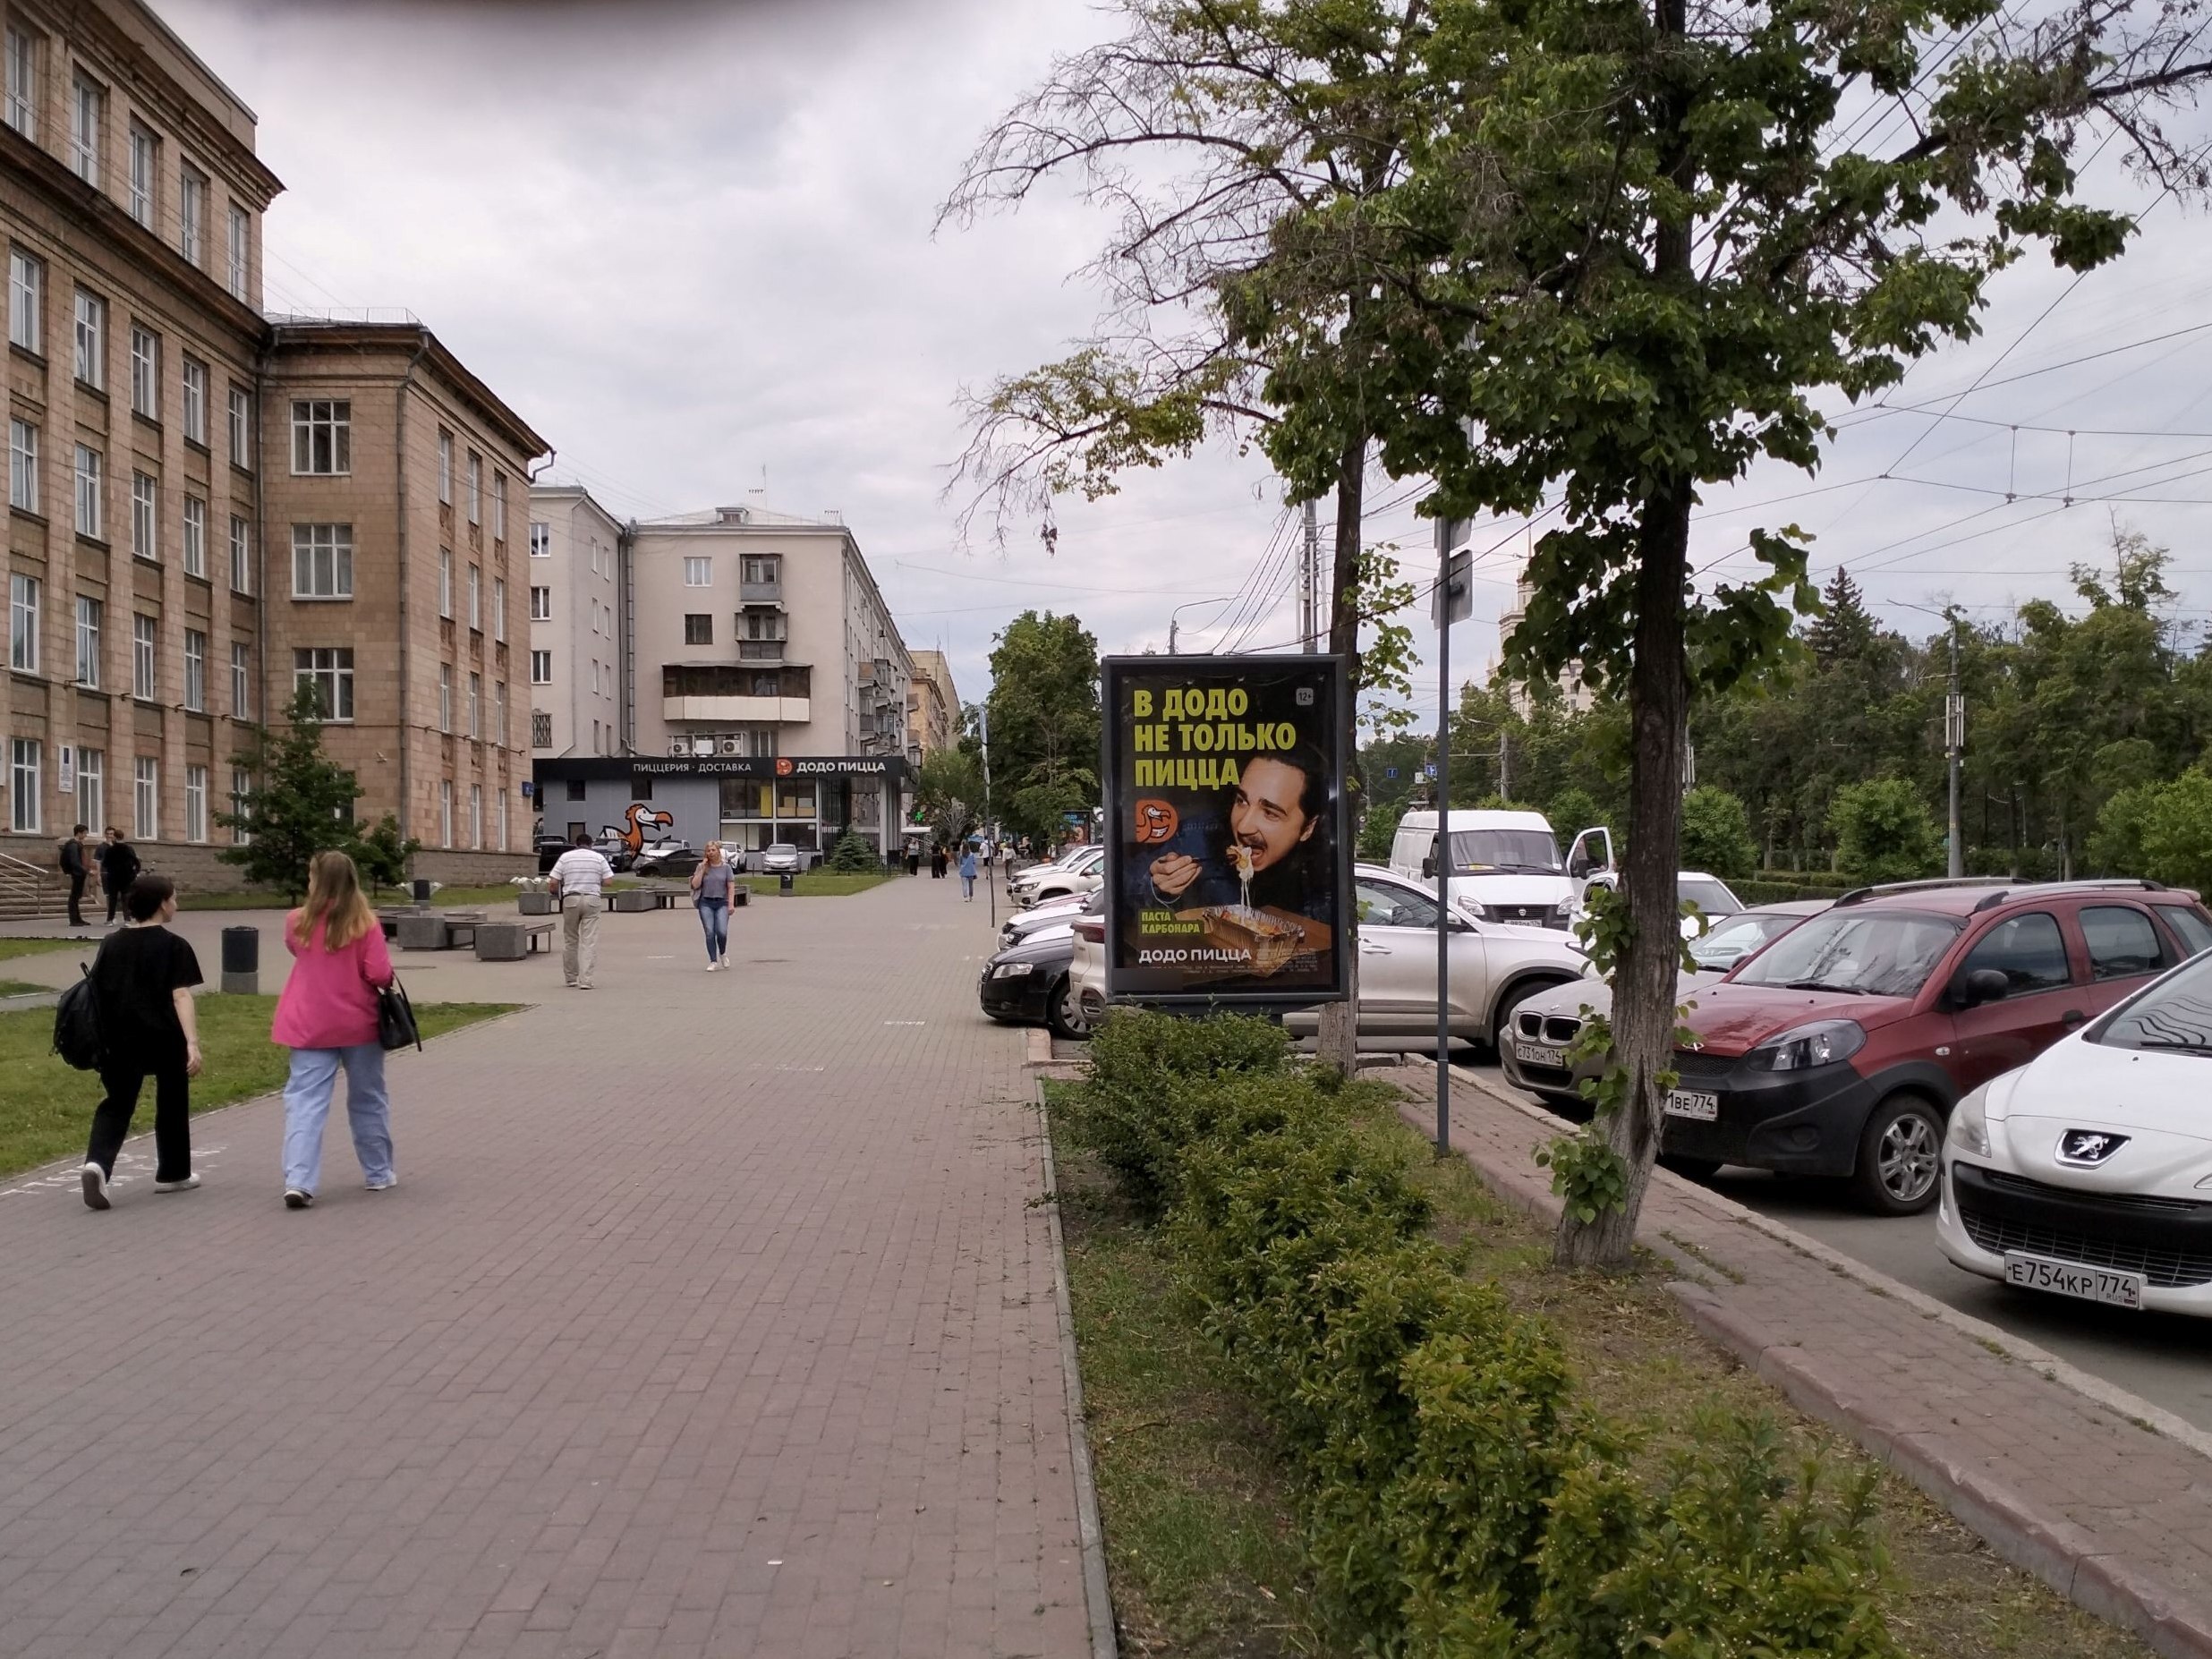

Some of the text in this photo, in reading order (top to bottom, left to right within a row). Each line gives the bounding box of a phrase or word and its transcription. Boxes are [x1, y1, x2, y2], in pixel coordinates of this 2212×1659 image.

[1134, 688, 1248, 721] В ДОДО
[1134, 722, 1297, 752] НЕ ТОЛЬКО
[634, 763, 752, 773] ПИЦЦЕРИЯ ДОСТАВКА
[796, 761, 886, 773] ДОДО ПИЦЦА
[1135, 758, 1240, 791] ПИЦЦА
[1141, 911, 1171, 923] ПАСТА
[1141, 923, 1201, 934] КАРБОНАРА
[1138, 949, 1187, 964] ДОДО
[1191, 949, 1253, 963] ПИЦЦА
[1668, 1092, 1714, 1111] 1ВЕ 774
[2012, 1261, 2131, 1297] Е754КР 774
